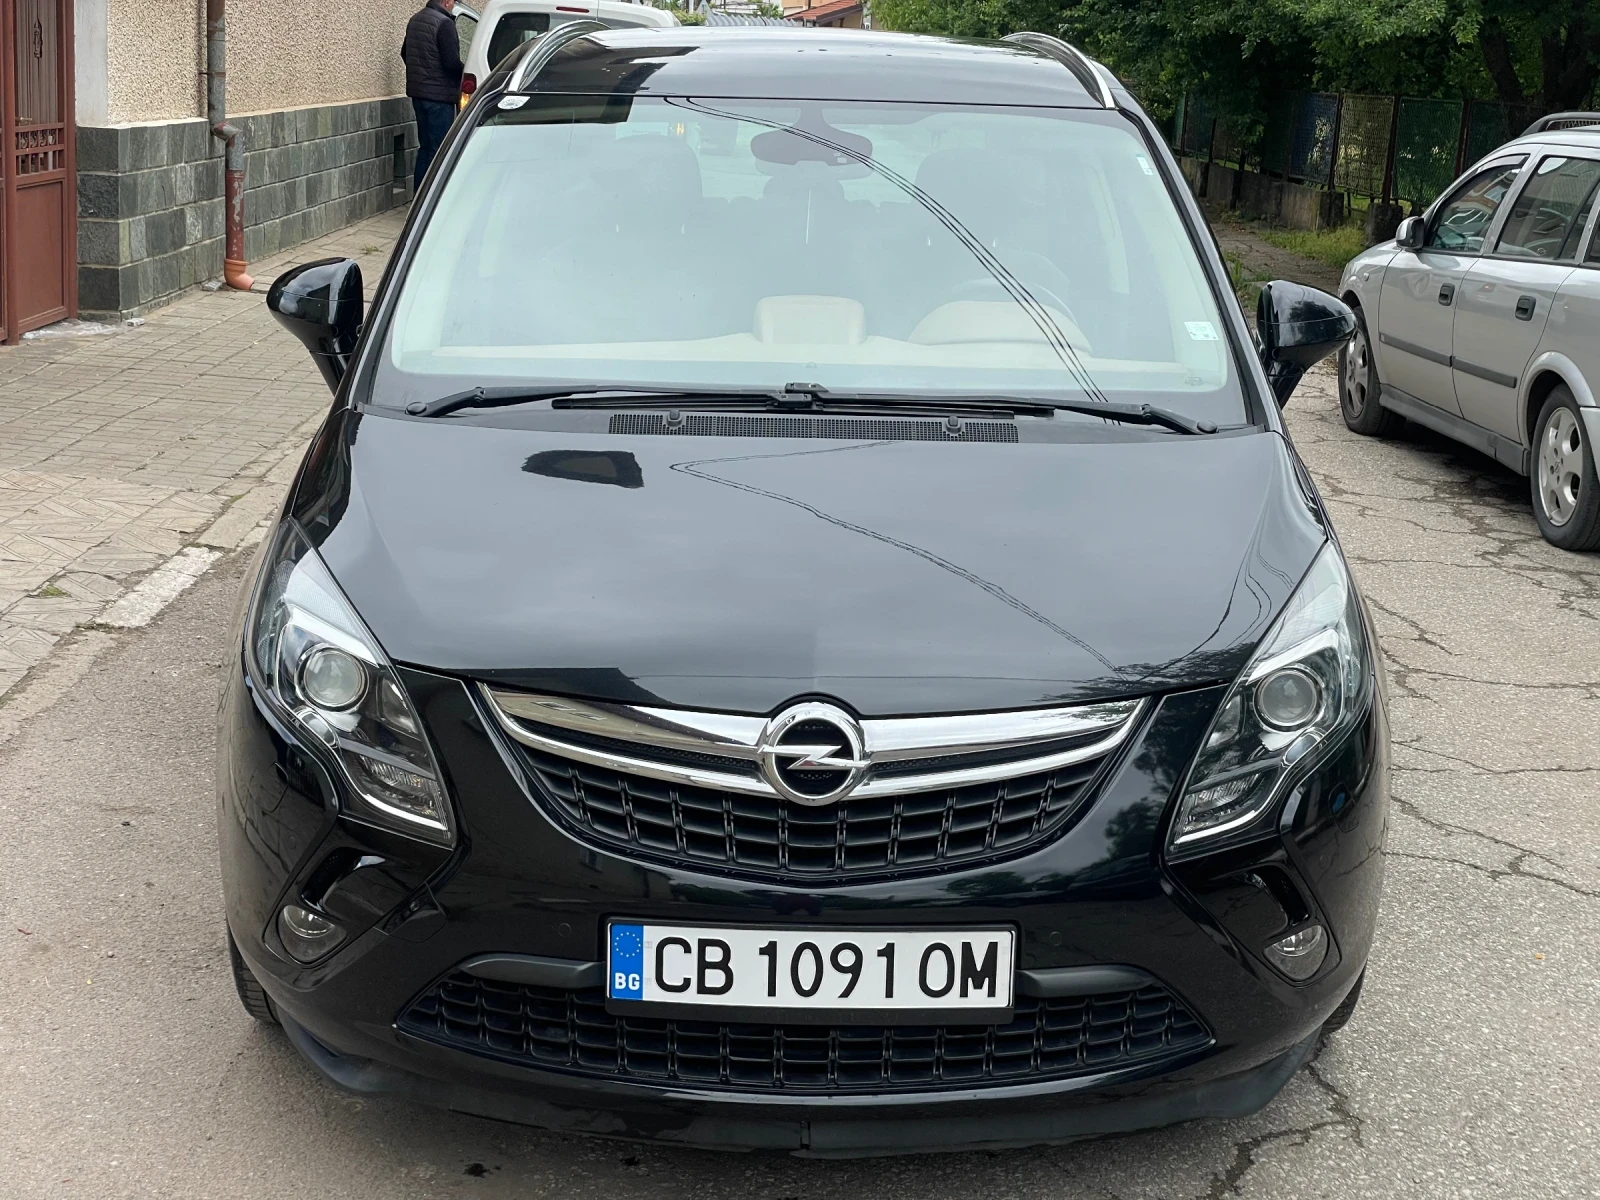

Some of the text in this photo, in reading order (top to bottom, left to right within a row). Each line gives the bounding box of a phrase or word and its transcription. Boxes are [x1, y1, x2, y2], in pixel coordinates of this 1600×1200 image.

[614, 972, 640, 991] BG
[655, 937, 999, 999] CB 1091 OM
